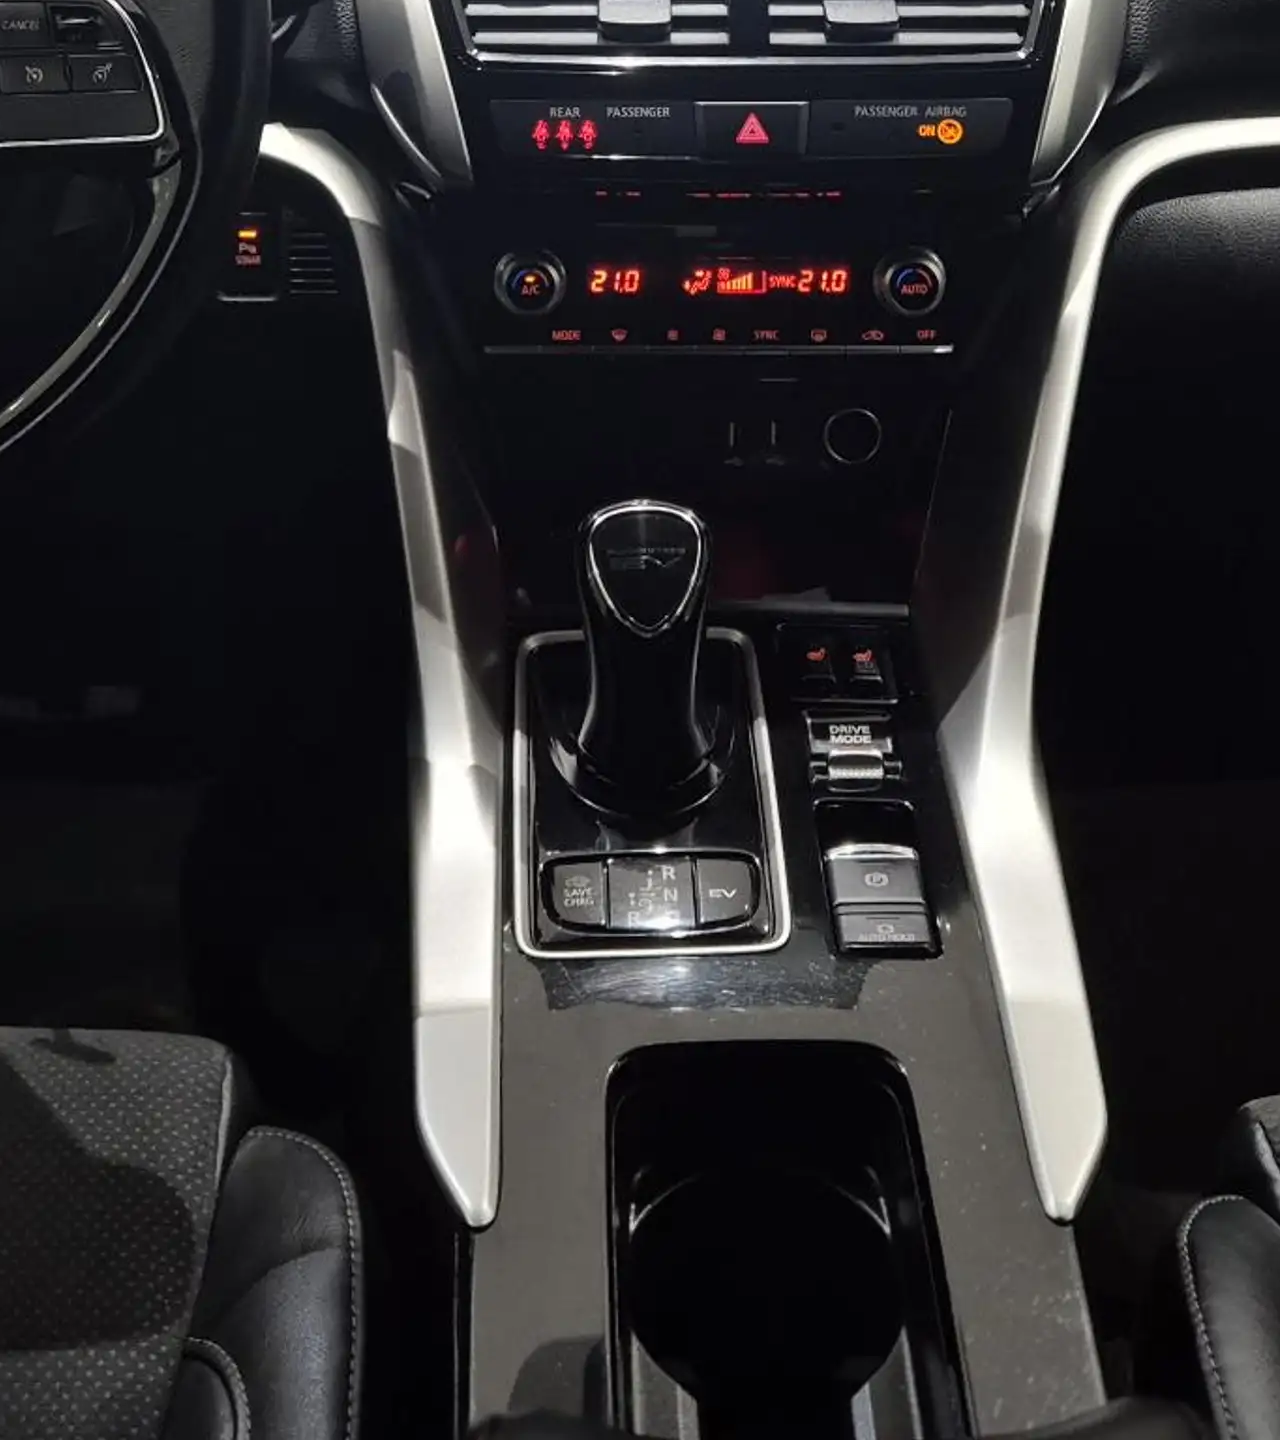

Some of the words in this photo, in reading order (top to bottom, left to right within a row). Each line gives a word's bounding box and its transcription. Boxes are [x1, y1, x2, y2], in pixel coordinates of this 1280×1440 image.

[1, 20, 40, 31] CANCEL
[549, 106, 581, 118] REAR
[606, 106, 670, 118] PASSENGER
[854, 105, 919, 118] PASSENGER
[925, 105, 967, 118] AIRBAG
[591, 270, 640, 292] 21.0
[769, 275, 796, 288] SYNC
[798, 269, 847, 292] 21.0
[521, 283, 541, 295] A/C
[900, 283, 929, 295] AUTO
[551, 329, 581, 340] MODE
[753, 329, 781, 340] SYNC
[917, 330, 937, 340] OFF
[829, 725, 871, 734] DRIVE
[830, 734, 872, 744] MODE
[661, 865, 676, 881] R
[709, 888, 737, 899] EV
